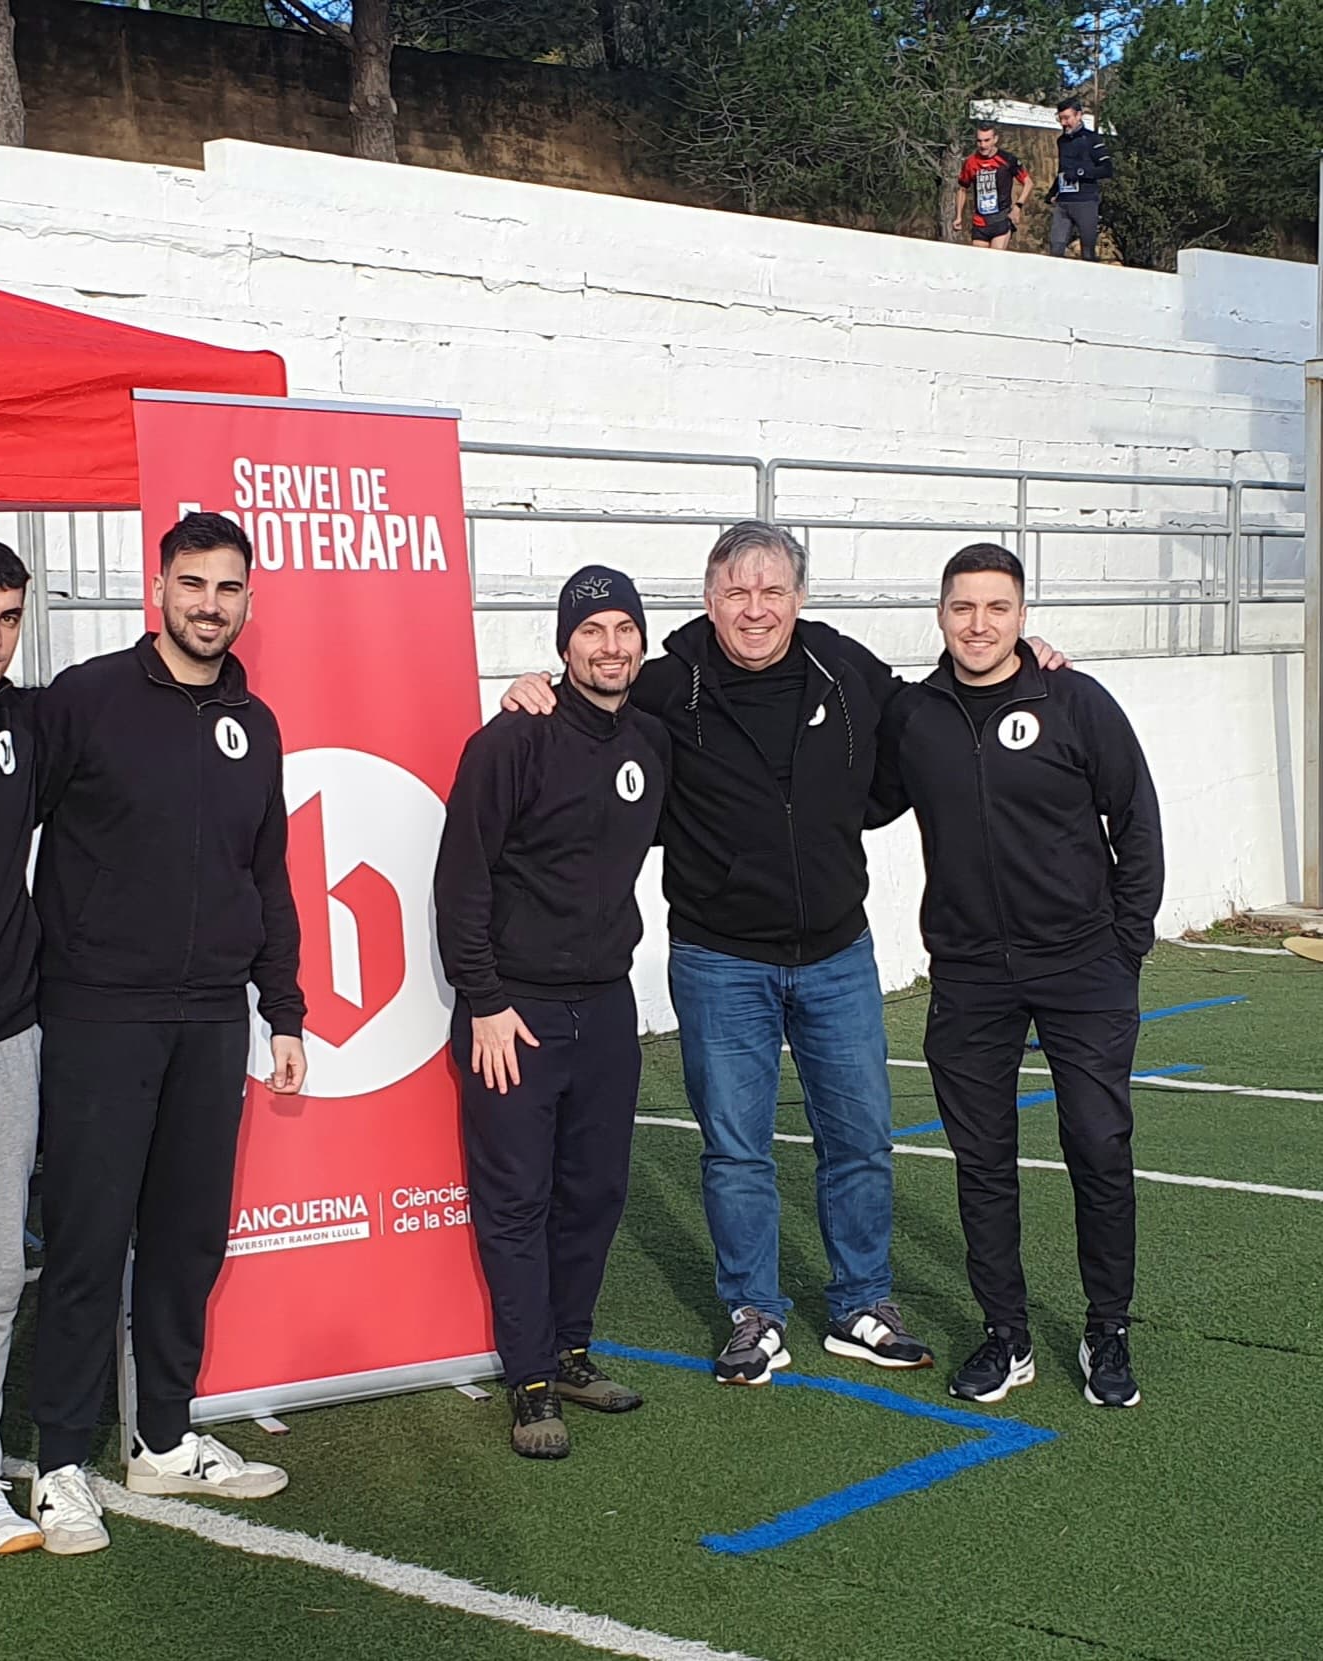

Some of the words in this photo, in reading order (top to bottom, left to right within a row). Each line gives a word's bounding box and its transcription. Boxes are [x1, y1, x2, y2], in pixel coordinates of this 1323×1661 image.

[233, 457, 341, 511] SERVEI
[351, 467, 390, 512] DE
[178, 502, 448, 571] IOTERÀPIA
[227, 1236, 286, 1252] NIVERSITAT
[288, 1231, 329, 1244] RAMON
[331, 1226, 361, 1239] LLULL
[393, 1212, 421, 1234] de
[423, 1209, 441, 1230] la
[443, 1204, 472, 1227] Sal
